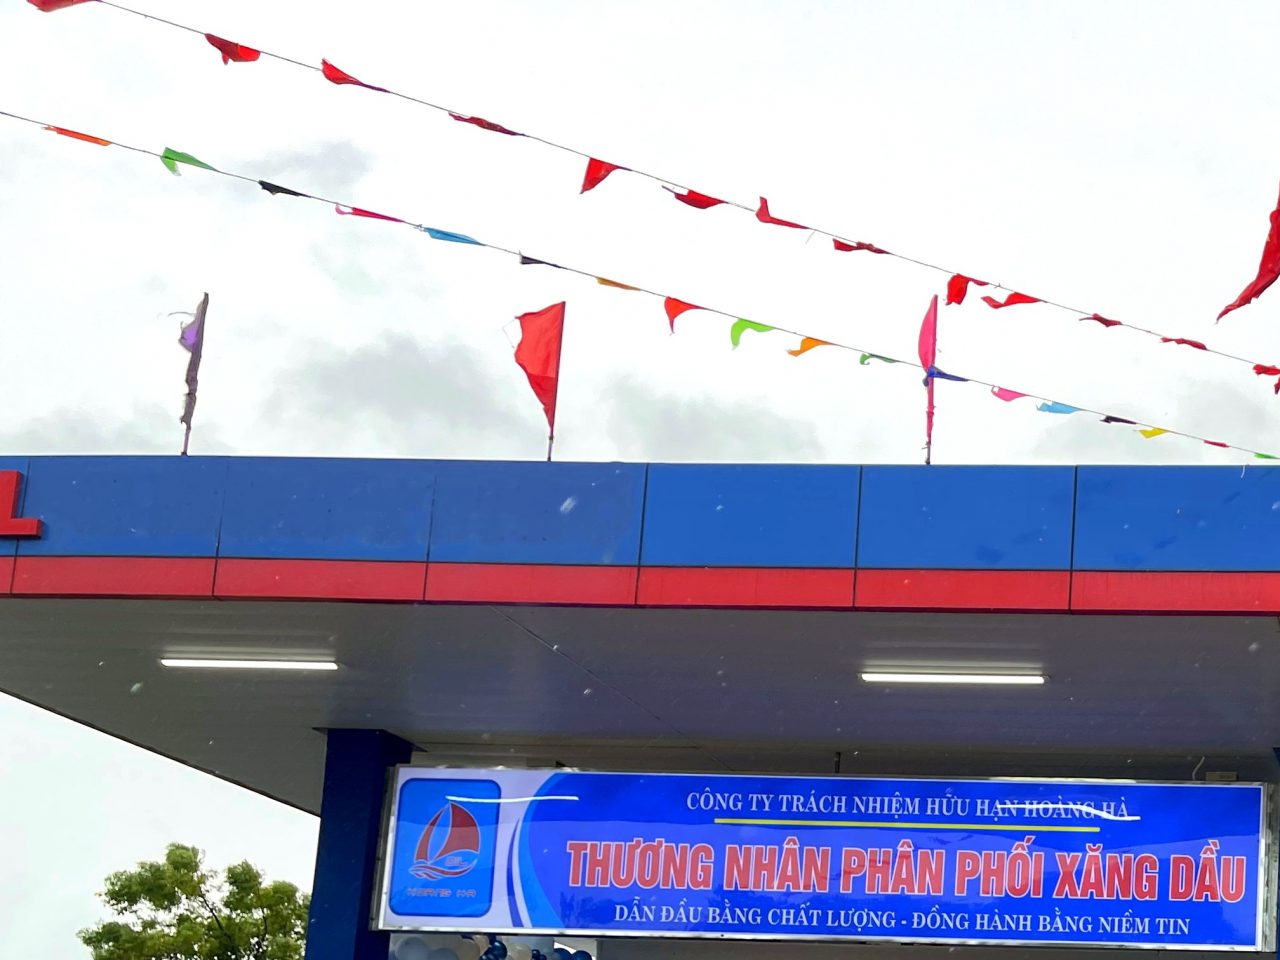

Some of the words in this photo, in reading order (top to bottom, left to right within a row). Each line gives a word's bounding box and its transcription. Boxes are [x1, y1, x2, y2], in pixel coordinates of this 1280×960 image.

[686, 787, 742, 812] CÔNG
[748, 794, 774, 812] TY
[779, 789, 846, 814] TRÁCH
[852, 793, 920, 819] NHIỆM
[925, 787, 970, 816] HỮU
[975, 797, 1018, 822] HẠN
[1023, 797, 1096, 819] HOÀNG
[1101, 797, 1129, 819] HÀ
[566, 838, 715, 890] THƯƠNG
[724, 837, 831, 893] NHÂN
[840, 839, 944, 896] PHÂN
[955, 835, 1043, 899] PHỐI
[1054, 844, 1159, 901] XĂNG
[1169, 840, 1247, 903] DẦU
[614, 896, 657, 923] DẪN
[660, 897, 702, 924] ĐẦU
[707, 898, 762, 925] BẰNG
[767, 901, 822, 927] CHẤT
[826, 906, 896, 933] LƯỢNG
[912, 904, 970, 931] ĐỒNG
[975, 908, 1033, 932] HÀNH
[1038, 906, 1093, 933] BẰNG
[1099, 907, 1151, 934] NIỀM
[1156, 917, 1191, 935] TIN
